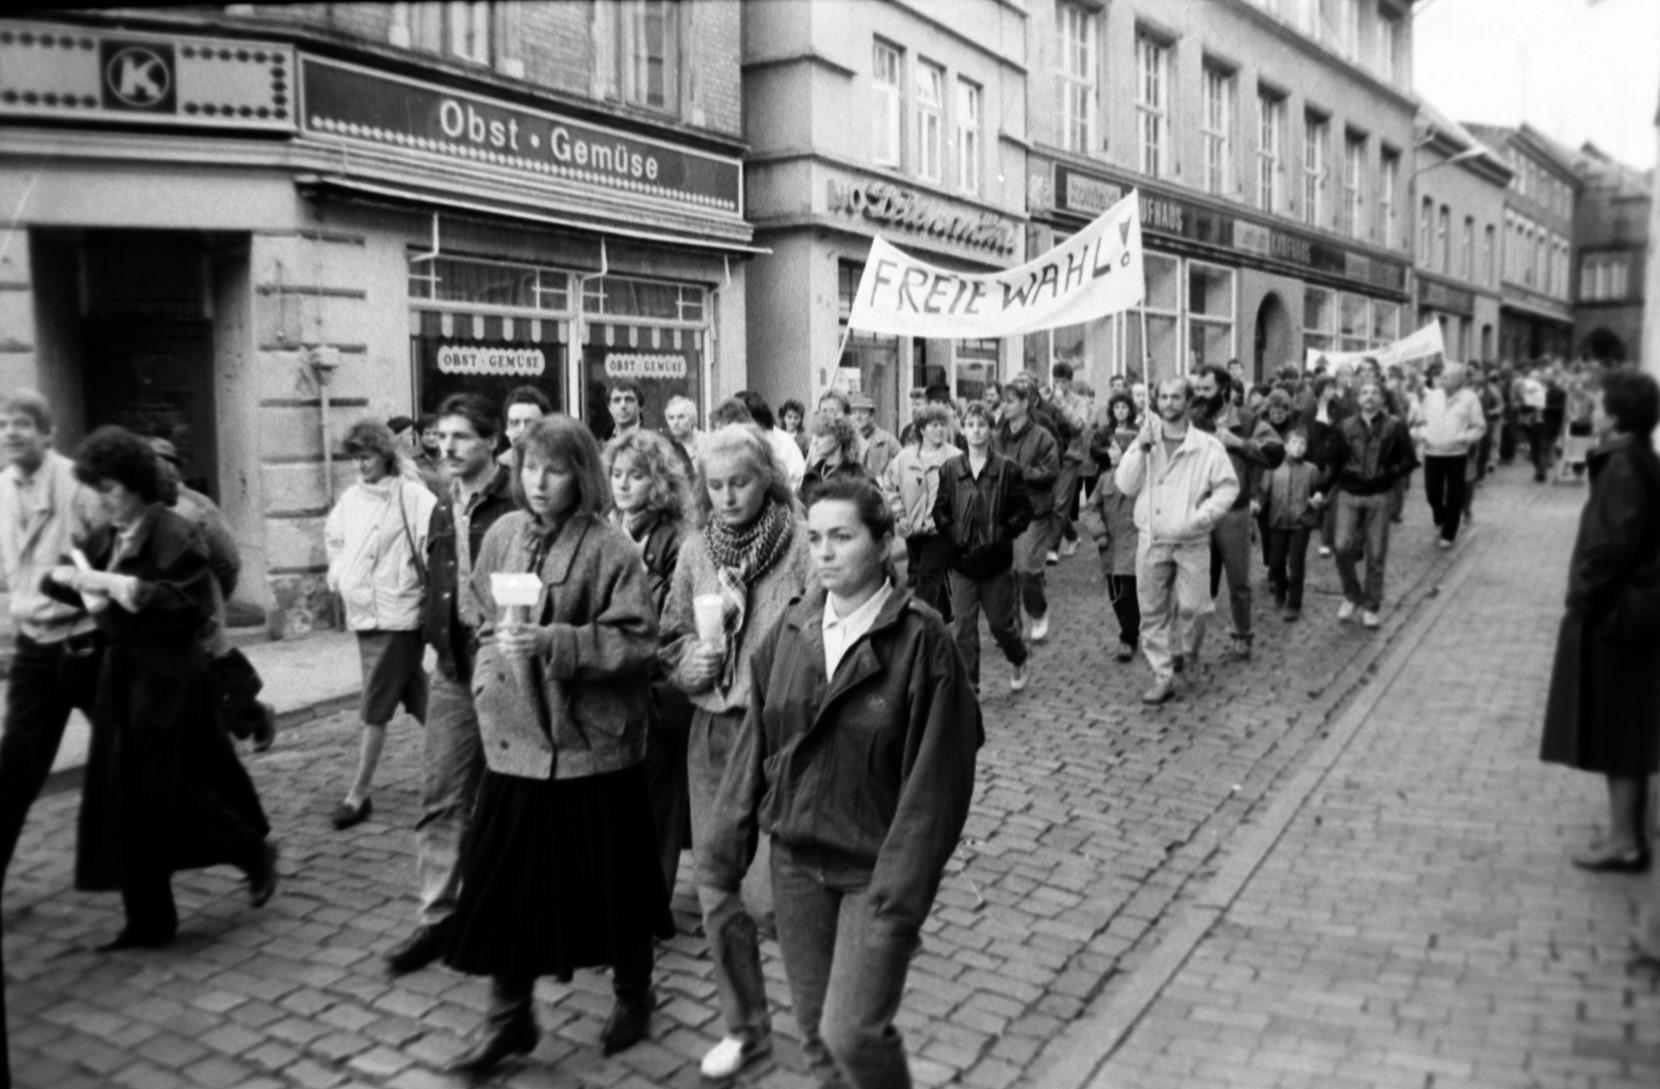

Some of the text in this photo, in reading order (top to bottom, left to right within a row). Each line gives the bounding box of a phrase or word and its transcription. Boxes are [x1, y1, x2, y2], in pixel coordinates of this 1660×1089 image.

[120, 55, 161, 97] K
[440, 99, 658, 180] Obst Gemüse
[870, 257, 987, 315] FREIE
[996, 214, 1132, 312] WAHL!
[443, 352, 540, 370] OBST GEMÜSE
[609, 357, 683, 373] OBST GEMÜSE
